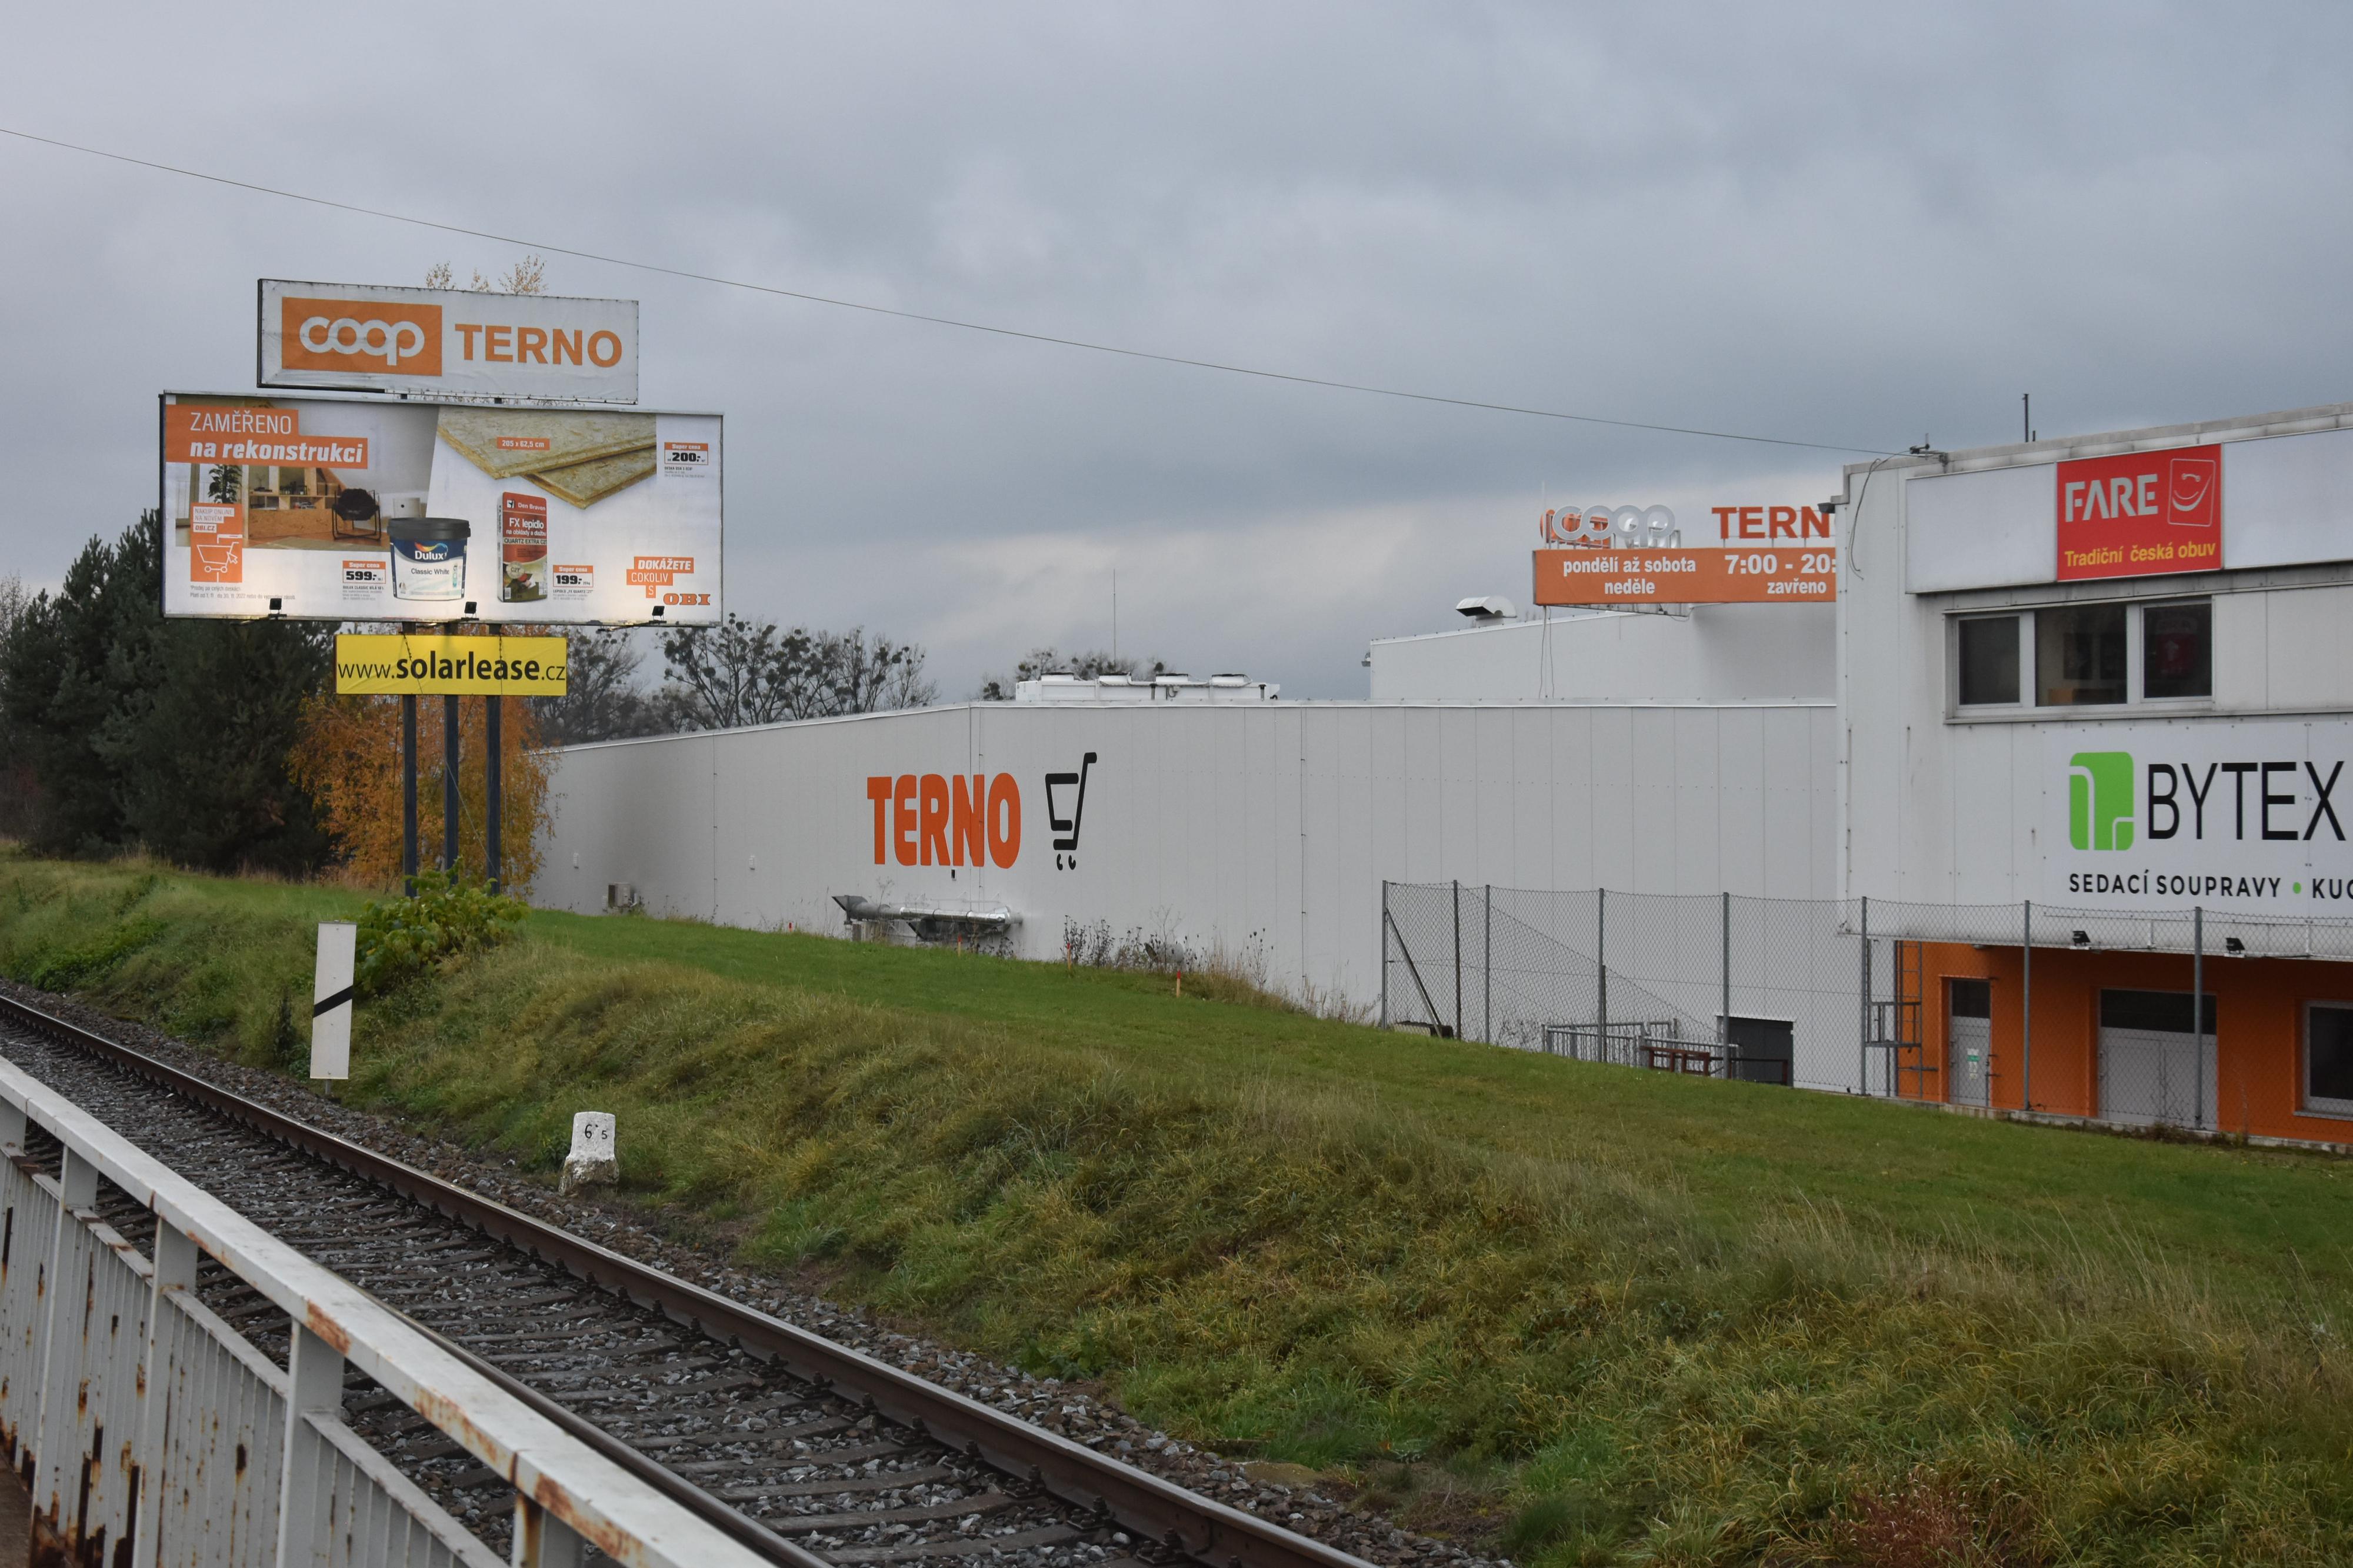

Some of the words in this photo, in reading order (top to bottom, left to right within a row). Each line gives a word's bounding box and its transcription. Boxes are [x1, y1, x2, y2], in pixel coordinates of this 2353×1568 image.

[299, 316, 425, 365] coop
[455, 323, 622, 368] TERNO
[191, 410, 291, 435] ZAMĚŘENO
[190, 442, 216, 458] na
[222, 440, 362, 463] rekonstrukci
[2065, 473, 2158, 522] FARE
[509, 518, 519, 527] FX
[522, 518, 544, 531] lepidlo
[1552, 505, 1675, 548] coop
[1712, 506, 1831, 539] TERN
[415, 551, 444, 560] Dulux
[638, 558, 691, 570] DOKÁŽETE
[1564, 557, 1618, 576] pondělí
[1624, 556, 1640, 573] až
[1645, 556, 1695, 573] sobota
[1725, 554, 1777, 575] 7:00
[2065, 546, 2124, 567] Tradiční
[2130, 542, 2174, 562] česká
[2178, 541, 2215, 558] obuv
[631, 572, 668, 583] COKOLIV
[1605, 578, 1655, 594] neděle
[1767, 578, 1827, 594] zavřeno
[648, 585, 654, 595] S
[663, 593, 711, 605] OBI
[338, 650, 565, 681] www.solarlease.cz
[2148, 760, 2347, 841] BYTEX
[867, 772, 1021, 869] TERNO
[2069, 869, 2150, 895] SEDACÍ
[2157, 875, 2281, 898] SOUPRAVY
